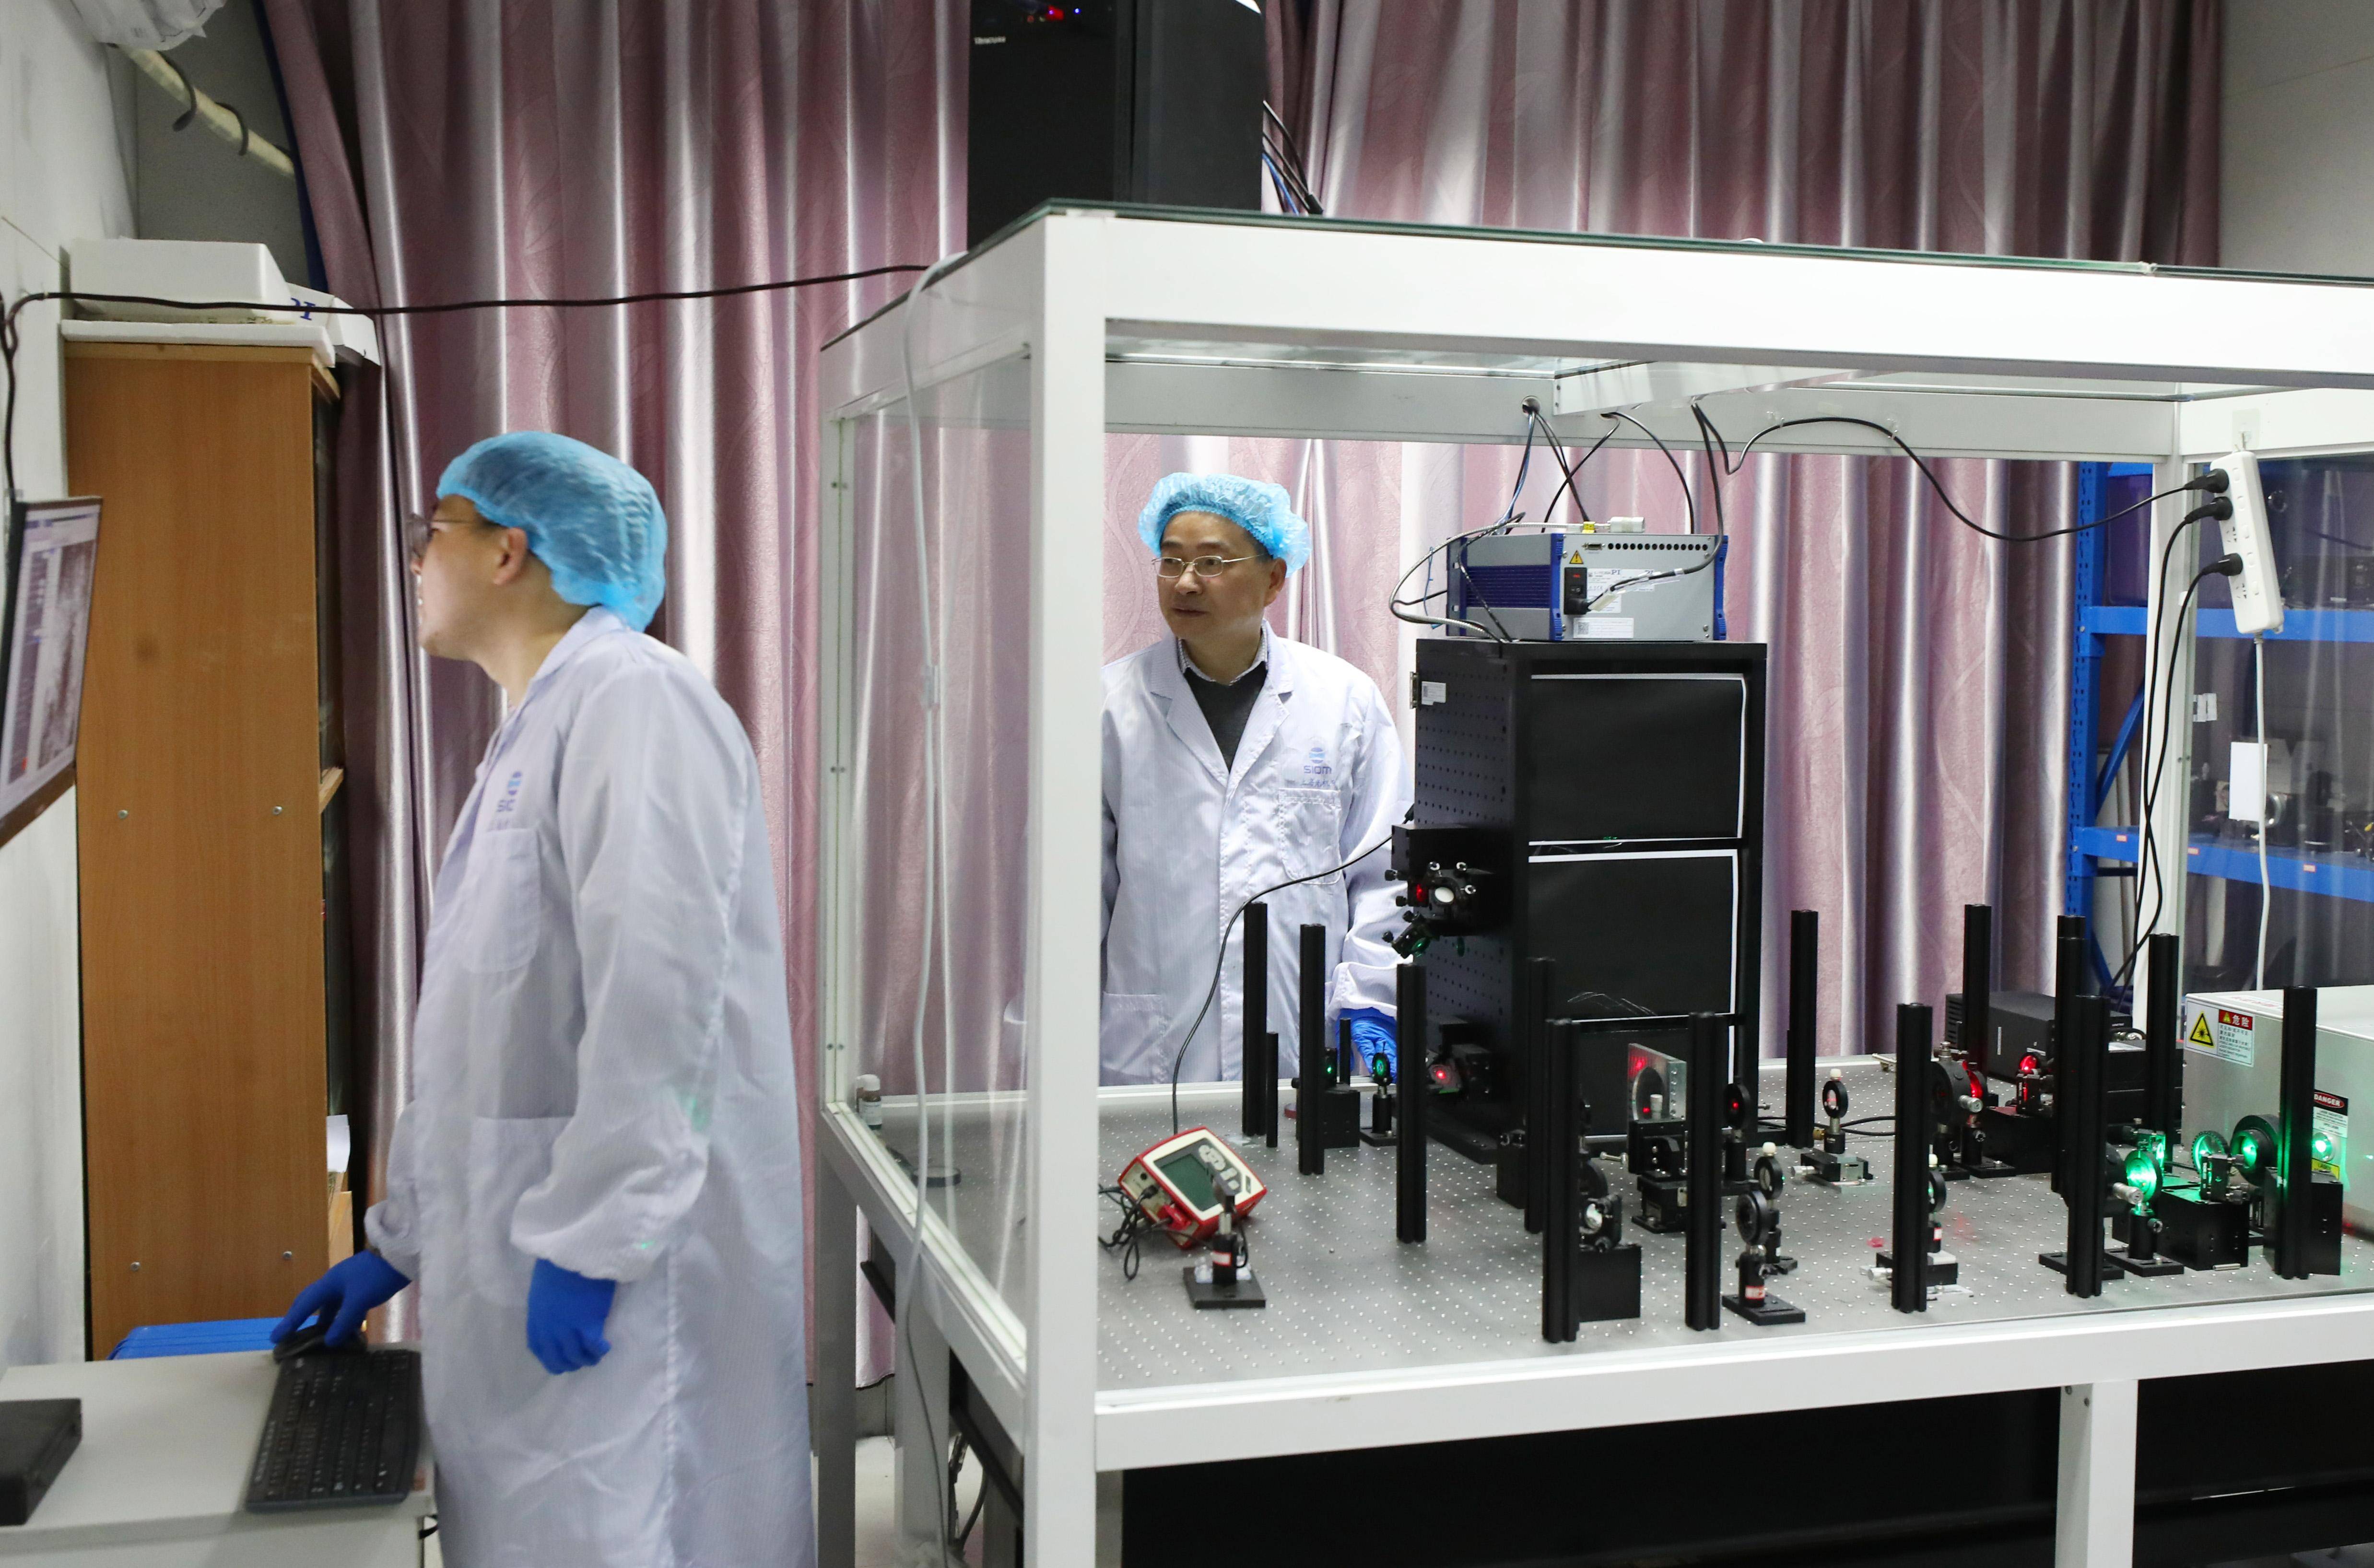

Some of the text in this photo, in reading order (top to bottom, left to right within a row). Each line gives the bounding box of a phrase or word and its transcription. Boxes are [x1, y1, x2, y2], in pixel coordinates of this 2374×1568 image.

[1304, 765, 1332, 774] SIOM
[2232, 1015, 2249, 1027] 危险
[2314, 1094, 2340, 1106] DANGER
